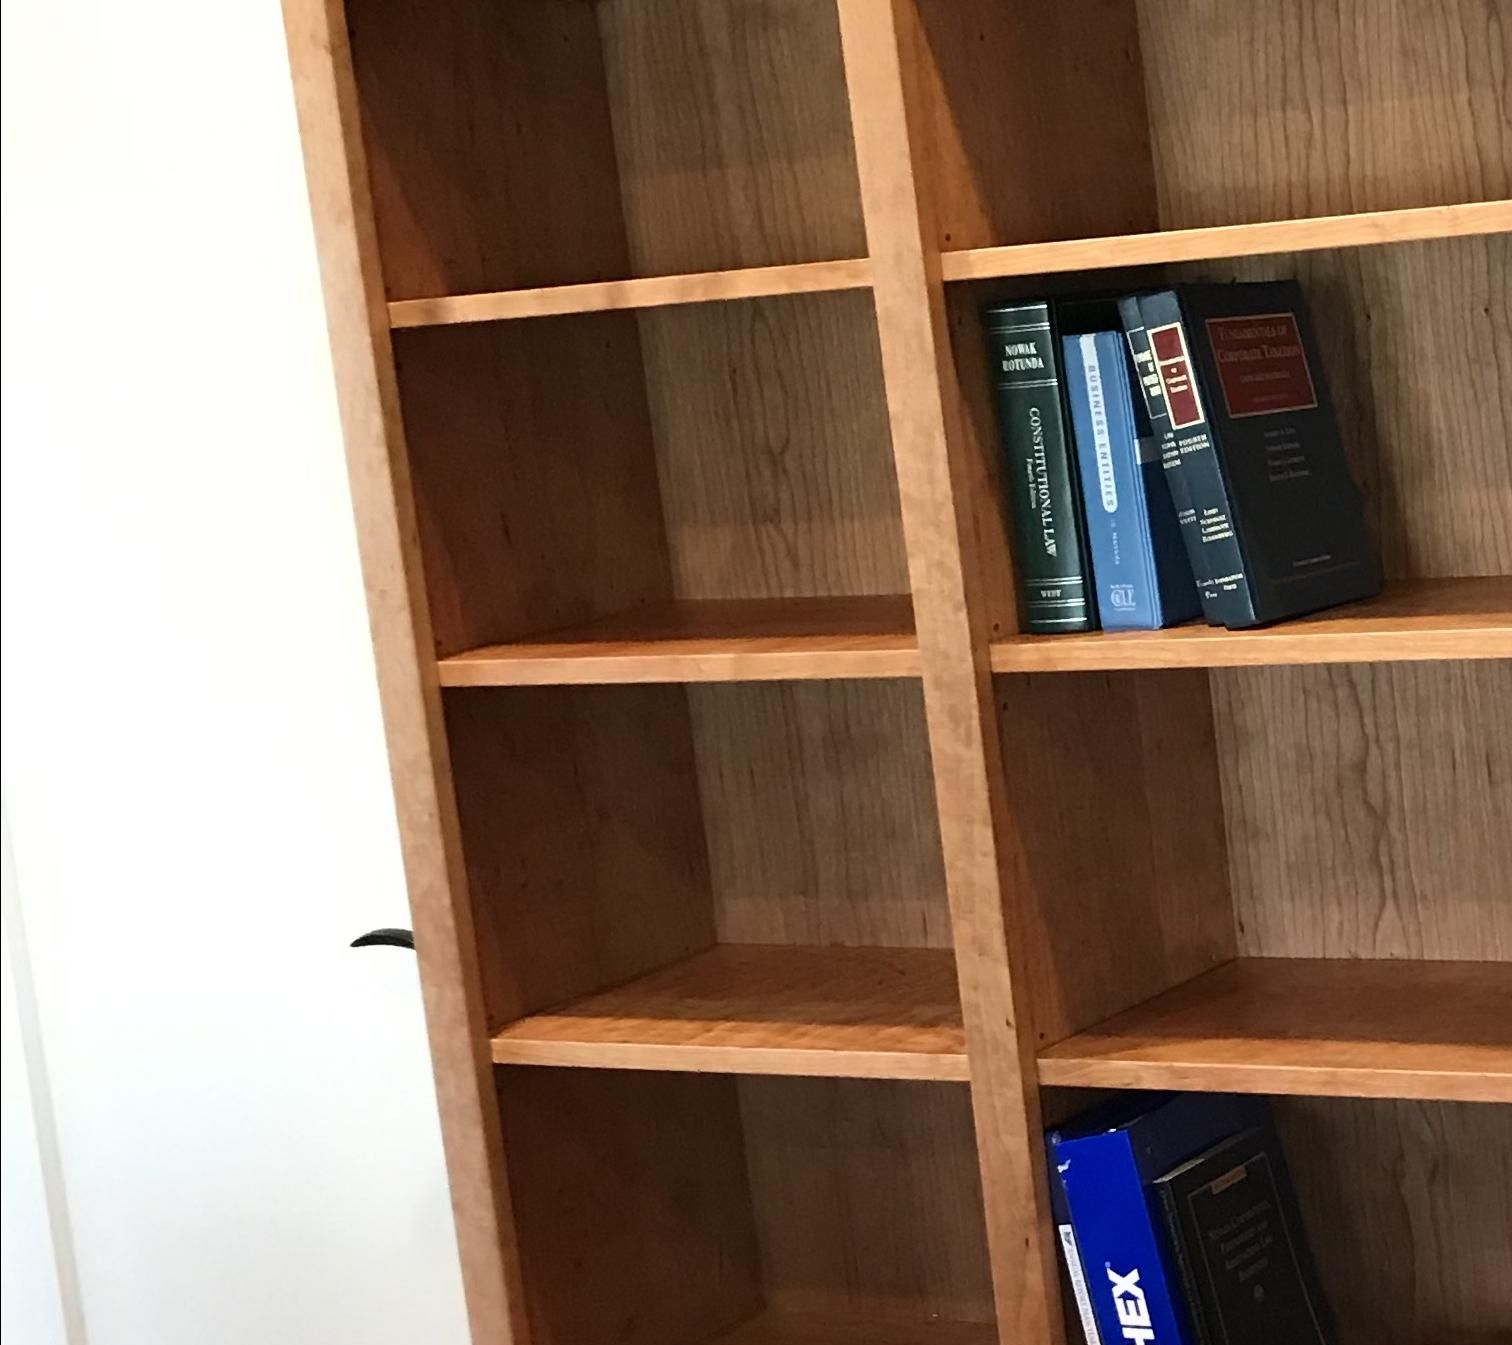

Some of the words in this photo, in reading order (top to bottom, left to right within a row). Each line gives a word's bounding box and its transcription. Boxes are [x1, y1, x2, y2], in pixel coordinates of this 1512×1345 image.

[1002, 356, 1045, 372] ROTUNDA
[1005, 342, 1037, 356] NOWAK
[1088, 364, 1105, 436] BUSINESS
[1099, 441, 1114, 507] ENTITIES
[1029, 407, 1053, 527] CONSTITUTIONAL
[1045, 528, 1057, 557] LAW
